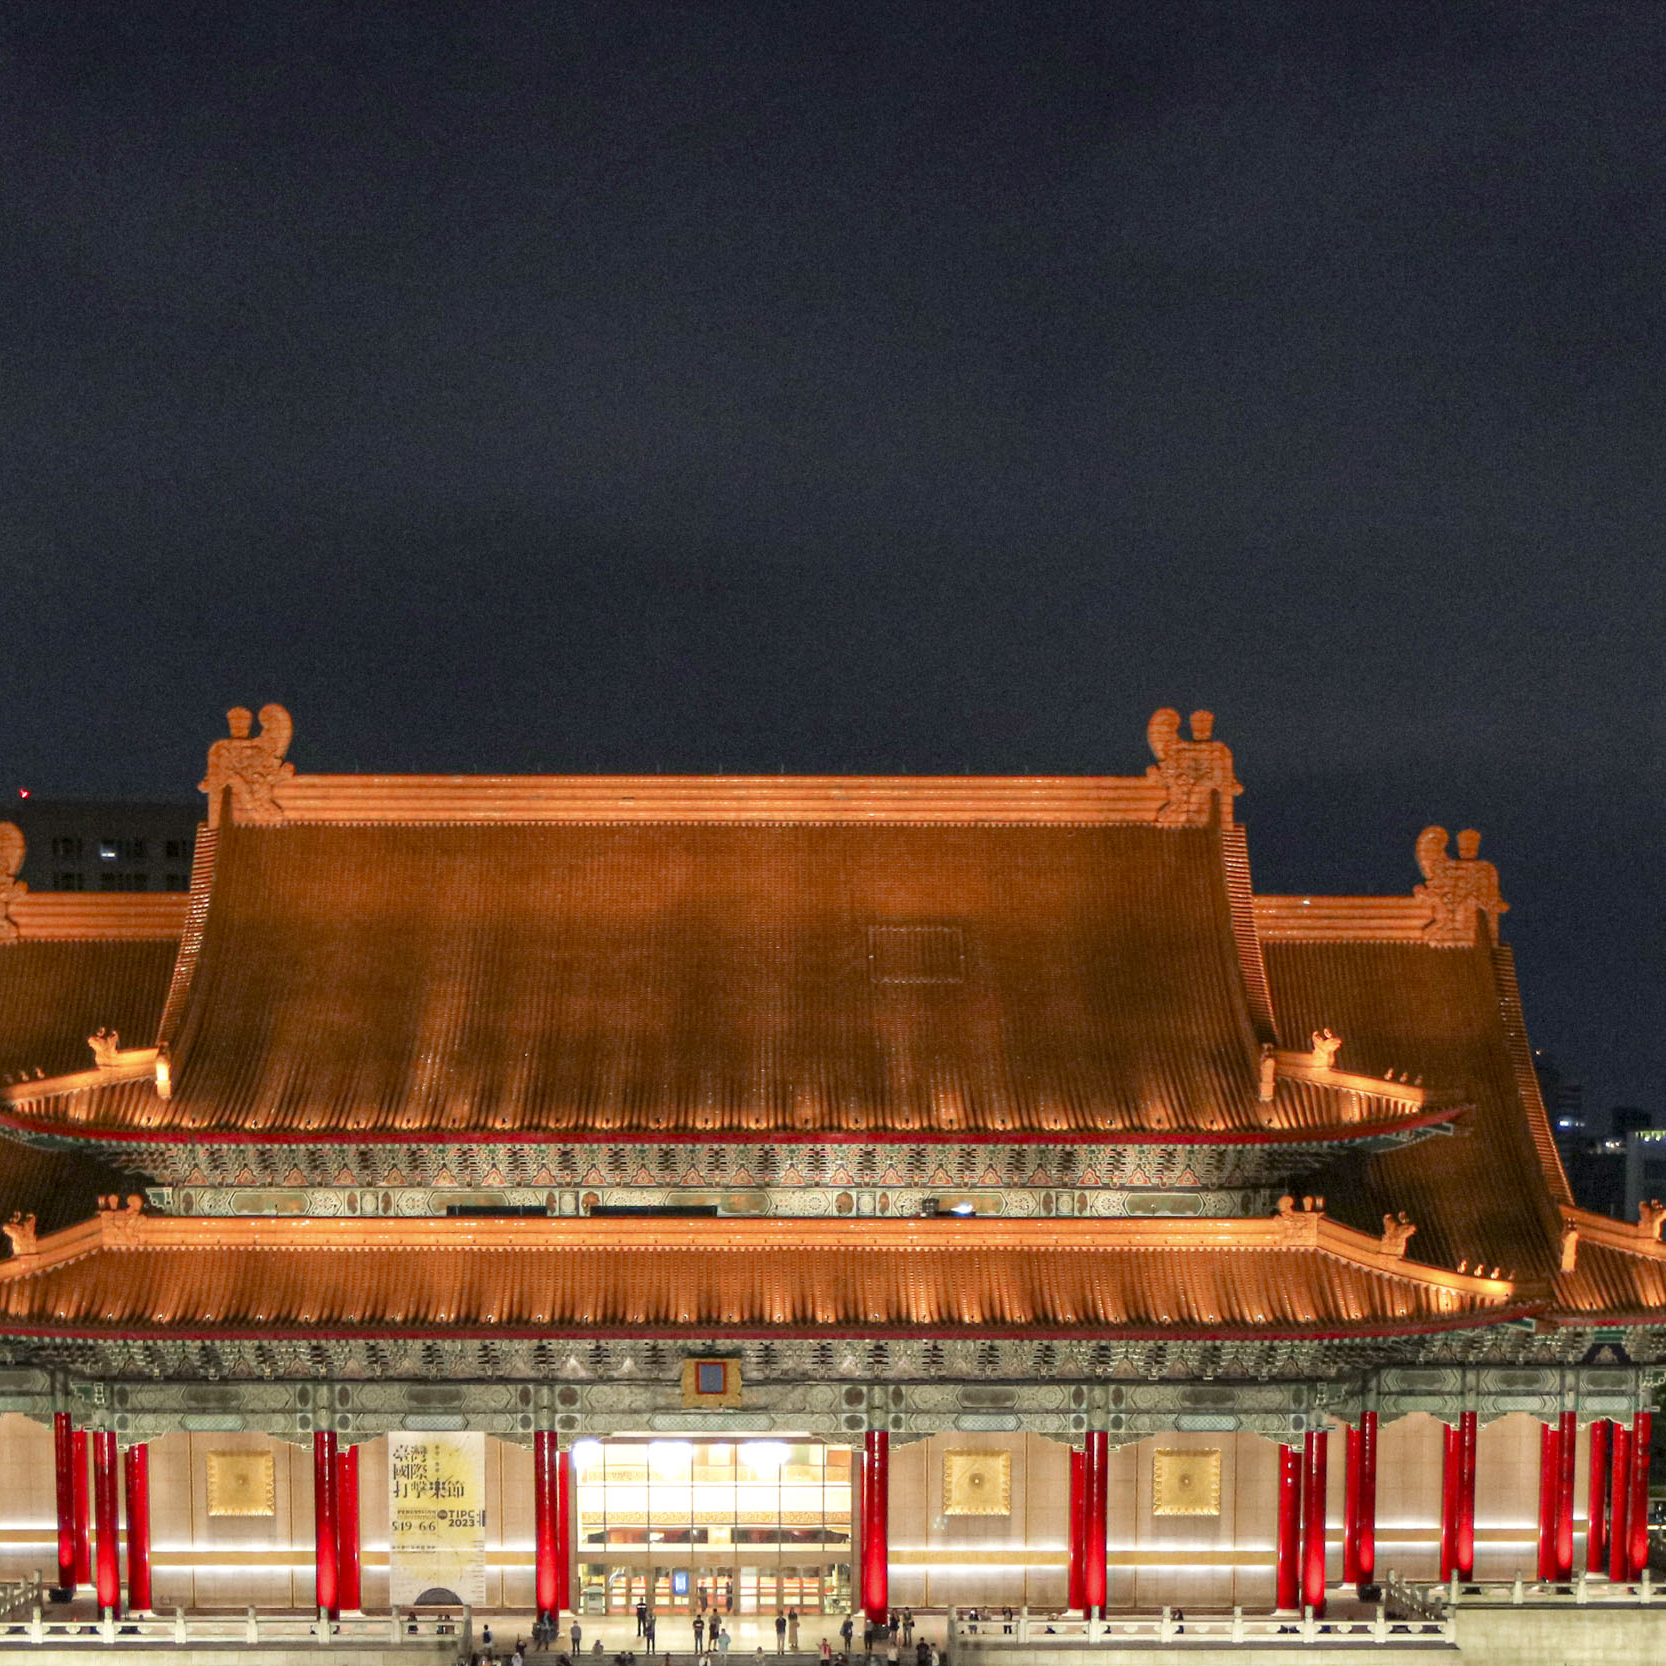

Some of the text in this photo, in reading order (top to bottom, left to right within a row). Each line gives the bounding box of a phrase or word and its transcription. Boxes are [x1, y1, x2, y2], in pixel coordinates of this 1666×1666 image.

[393, 1464, 428, 1480] 國際
[448, 1510, 475, 1518] TIPC
[448, 1519, 475, 1528] 2023
